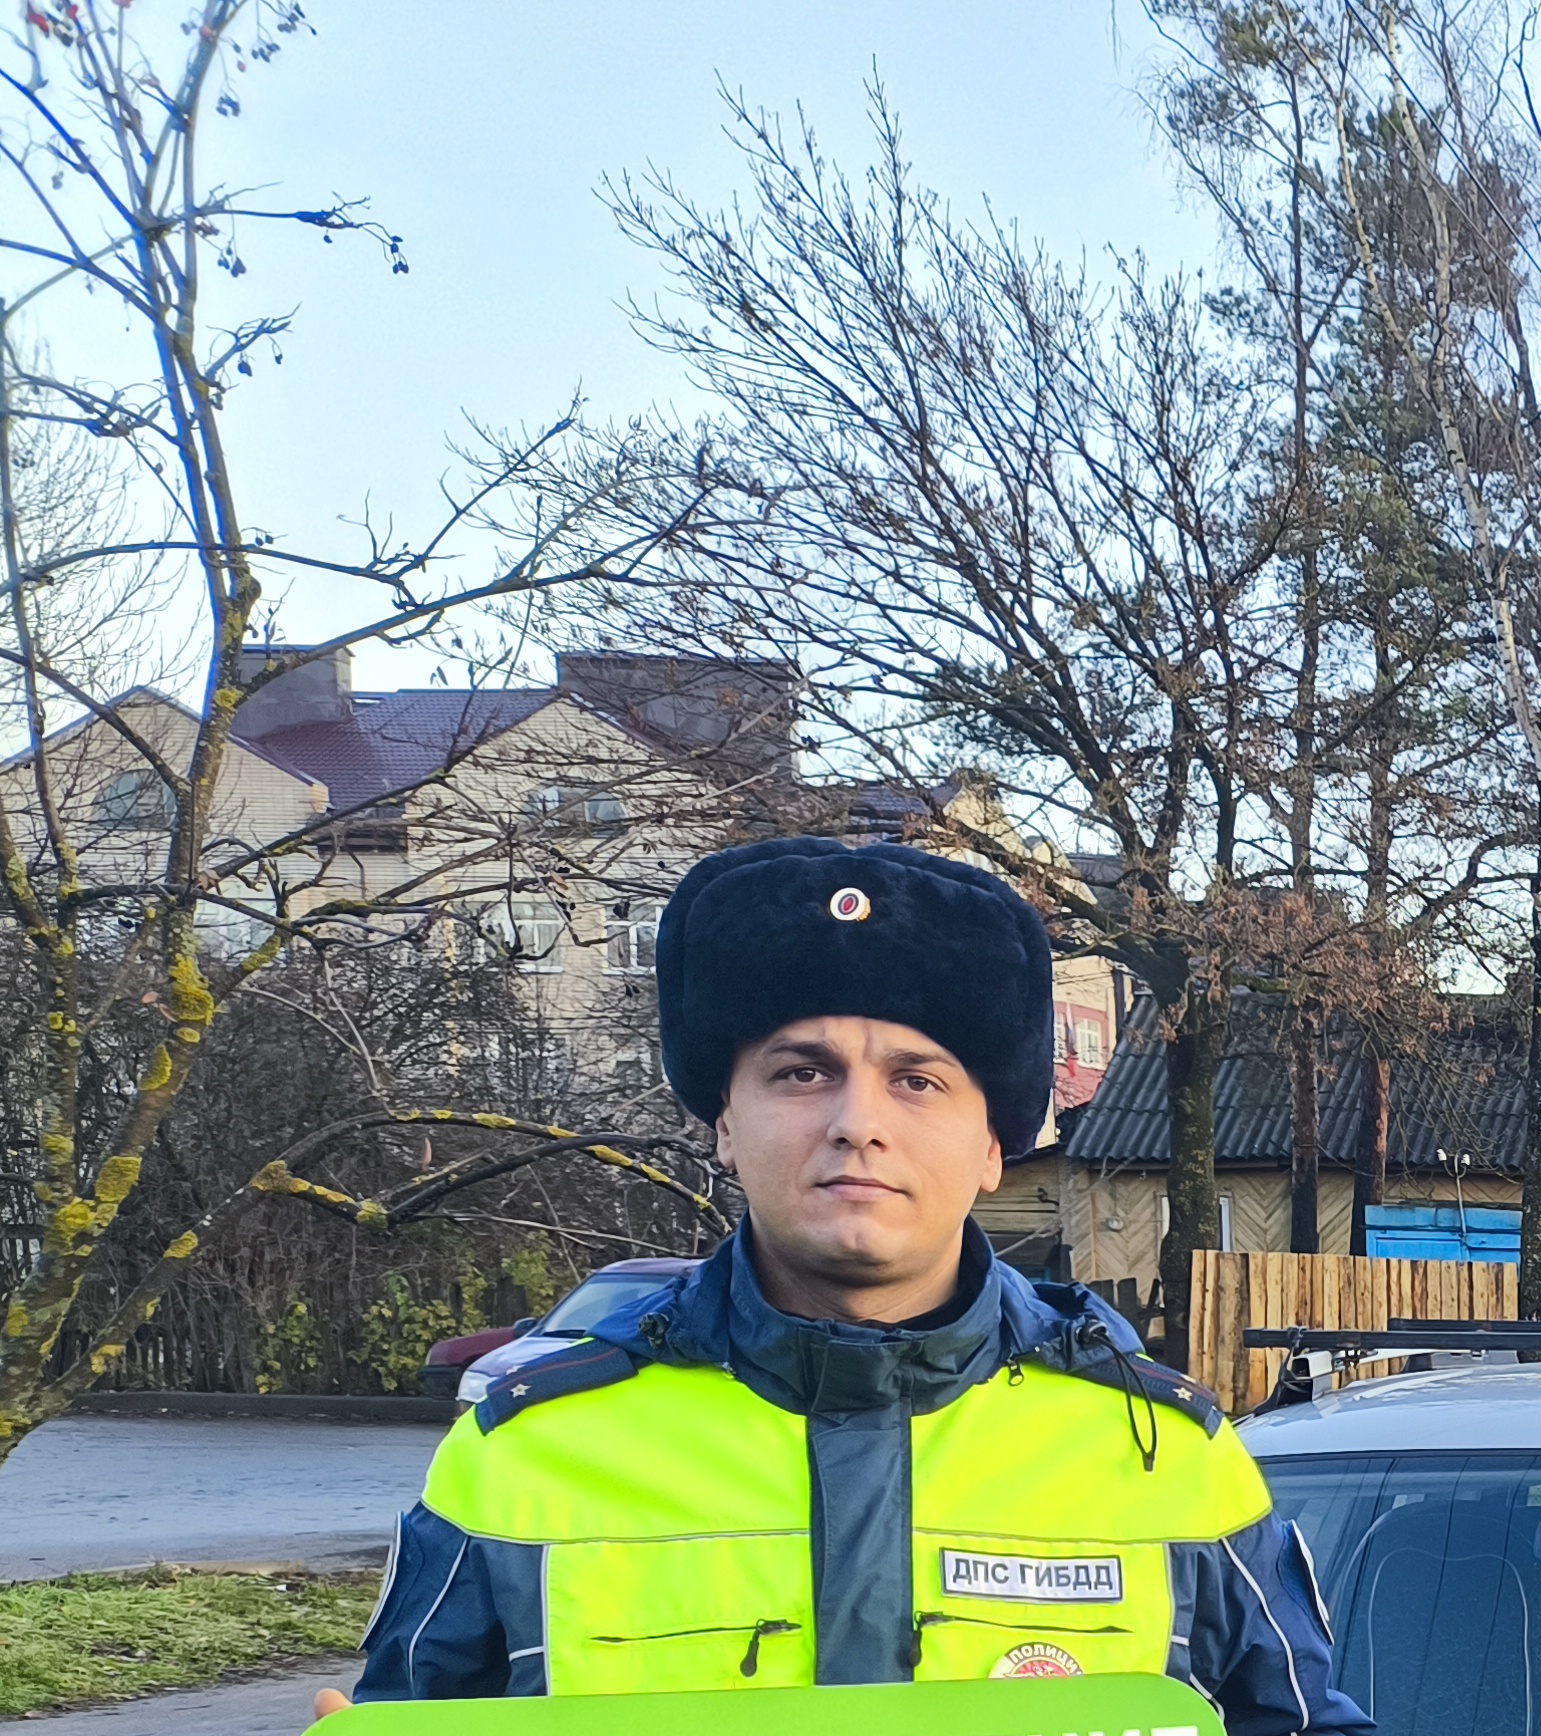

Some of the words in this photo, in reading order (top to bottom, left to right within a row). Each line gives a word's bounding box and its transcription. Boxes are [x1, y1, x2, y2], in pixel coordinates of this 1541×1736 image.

[952, 1557, 1009, 1585] ДПС
[1019, 1563, 1113, 1590] ГИБДД
[1008, 1644, 1083, 1675] ПОЛИЦИ
